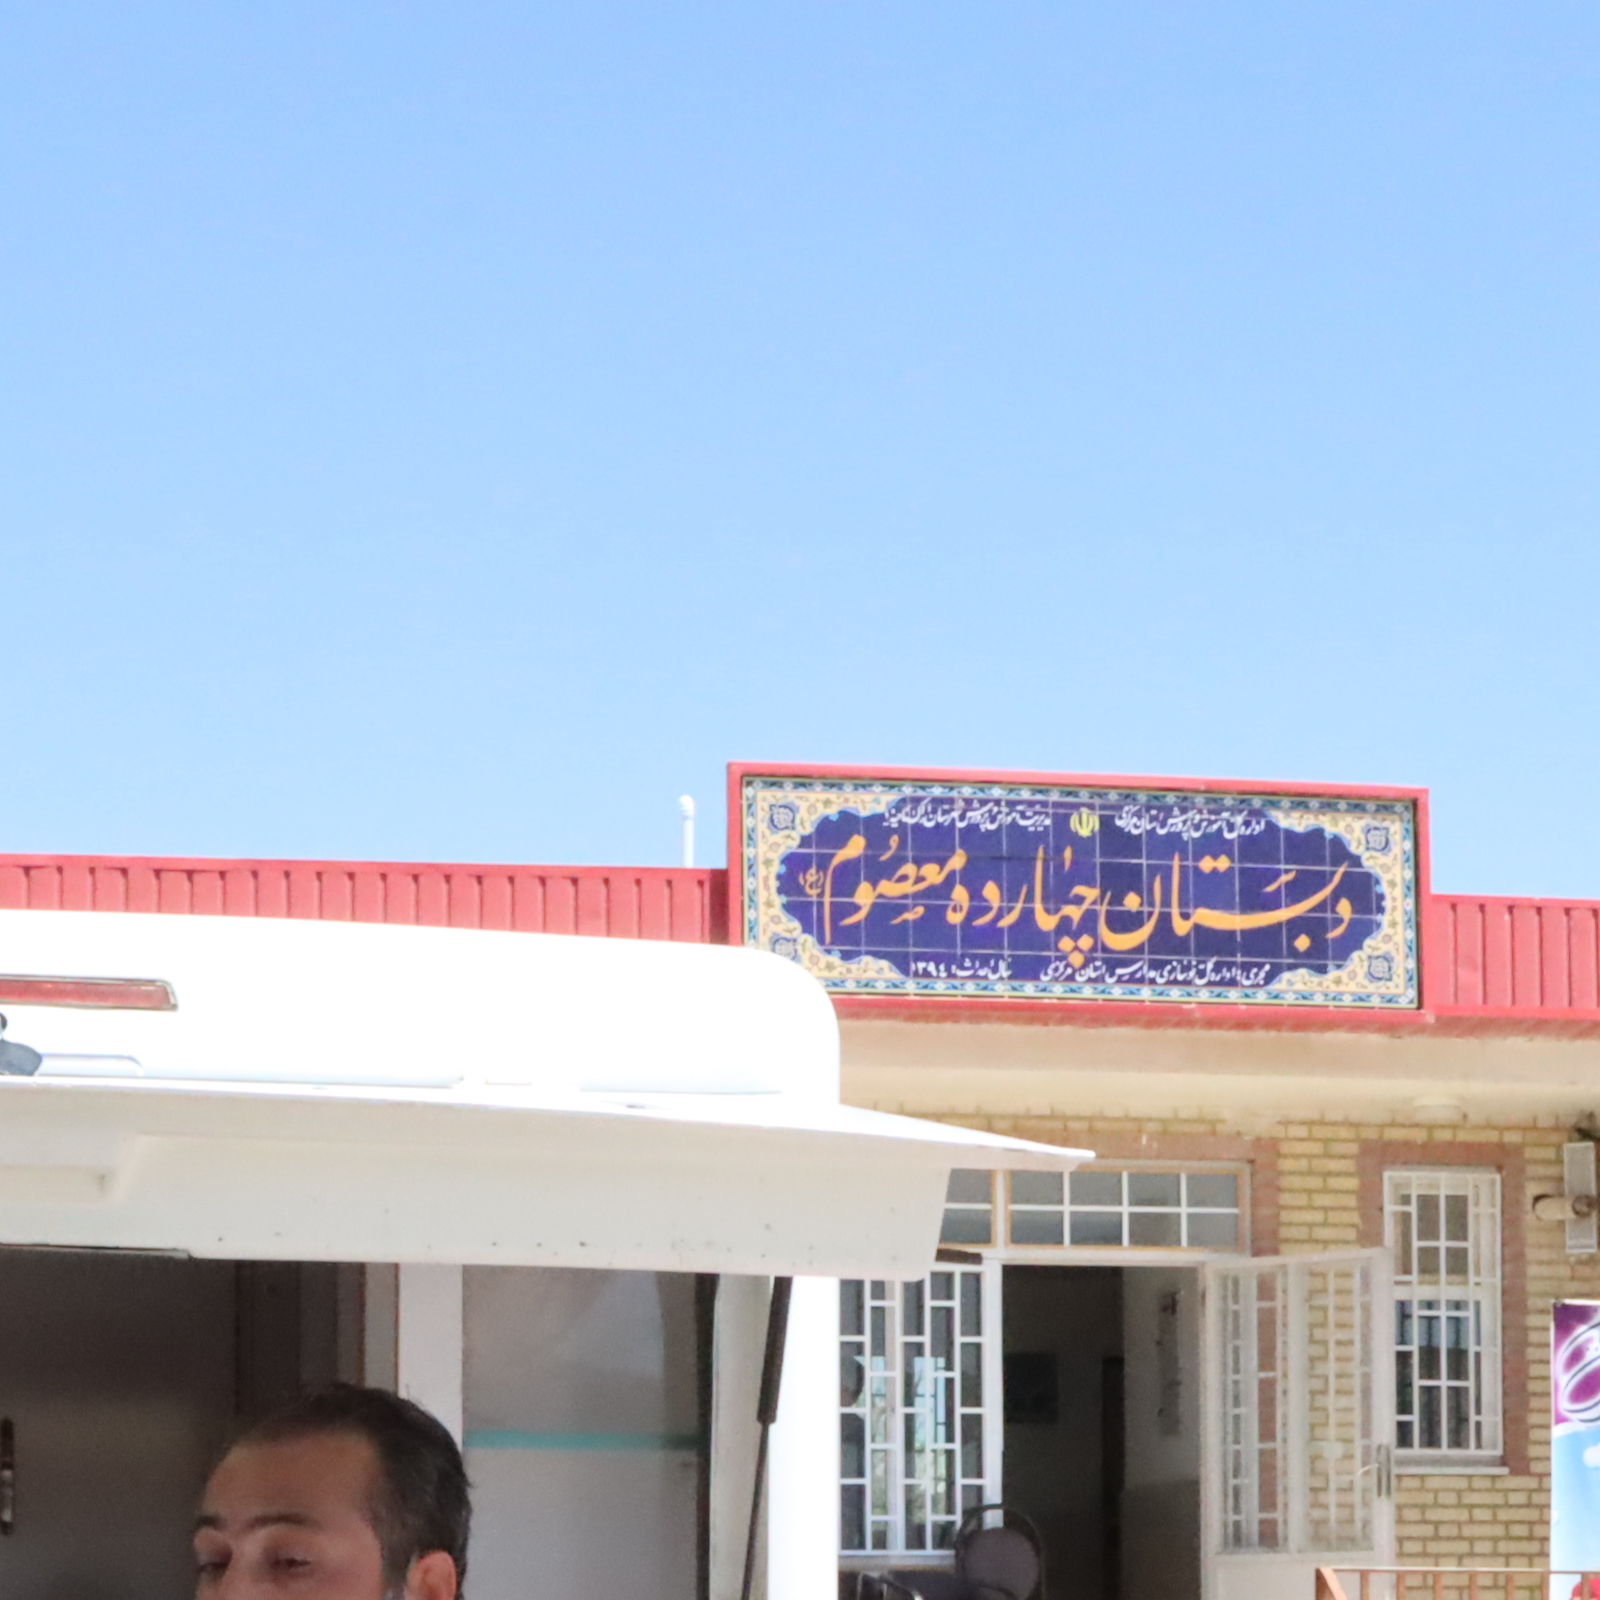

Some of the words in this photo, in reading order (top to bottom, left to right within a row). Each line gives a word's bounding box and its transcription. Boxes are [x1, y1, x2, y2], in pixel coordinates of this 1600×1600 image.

[945, 845, 1101, 968] چهارده
[1099, 852, 1353, 953] دبستان
[1039, 960, 1073, 983] مرکزی
